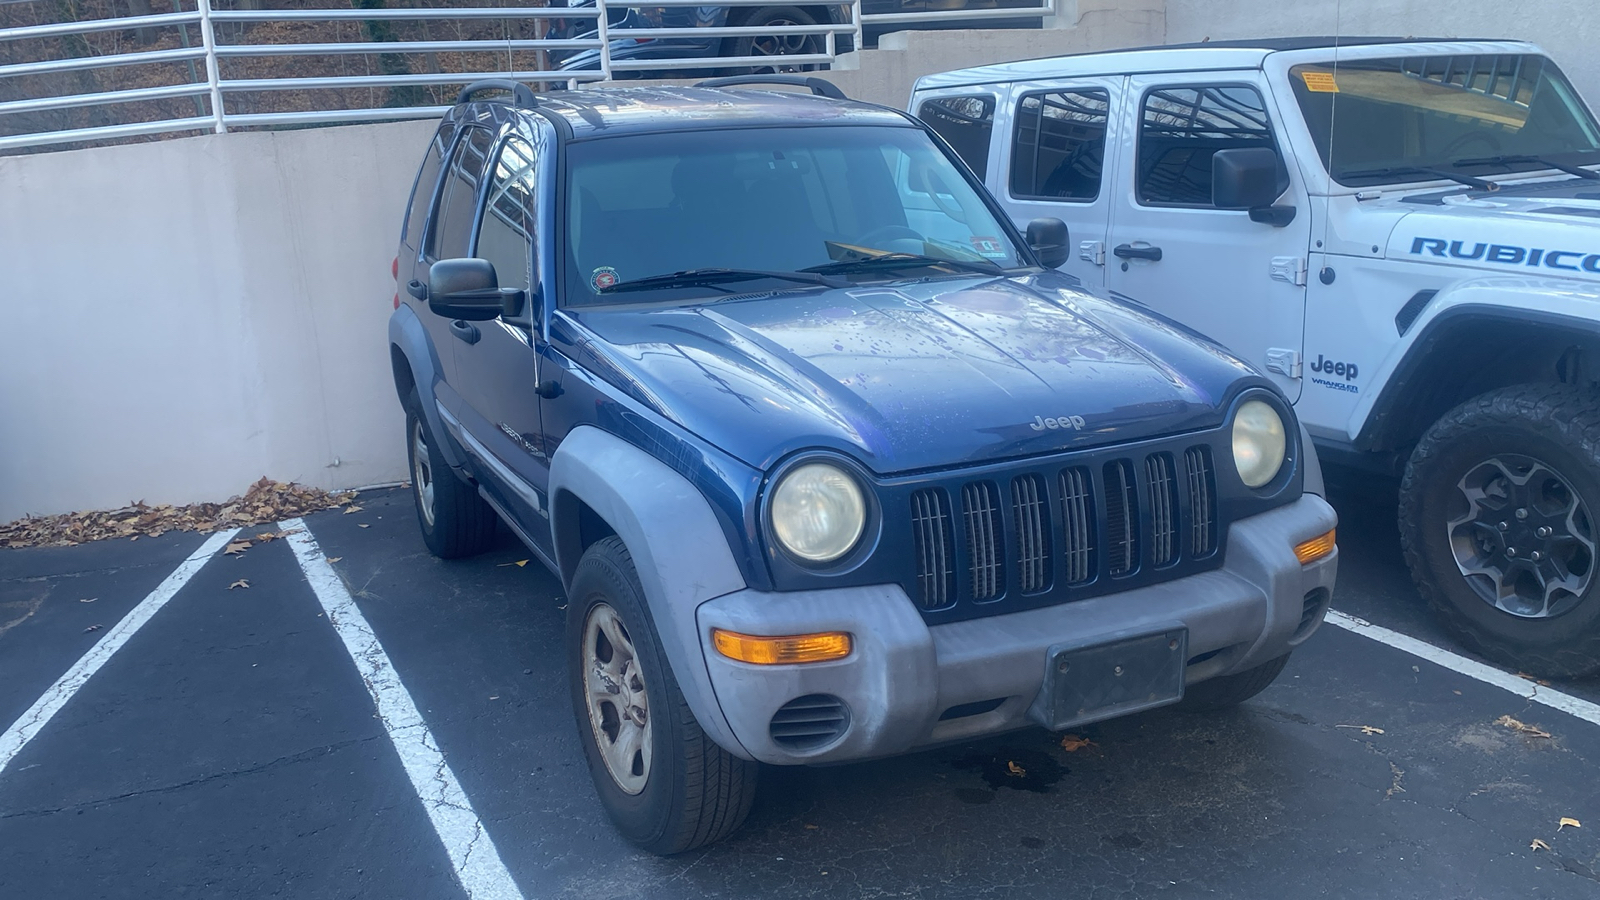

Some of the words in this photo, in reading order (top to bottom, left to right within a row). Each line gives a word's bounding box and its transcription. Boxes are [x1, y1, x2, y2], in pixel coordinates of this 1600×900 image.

[1310, 354, 1359, 381] Jeep
[1311, 377, 1358, 391] WRANGLER
[1029, 415, 1086, 431] Jeep
